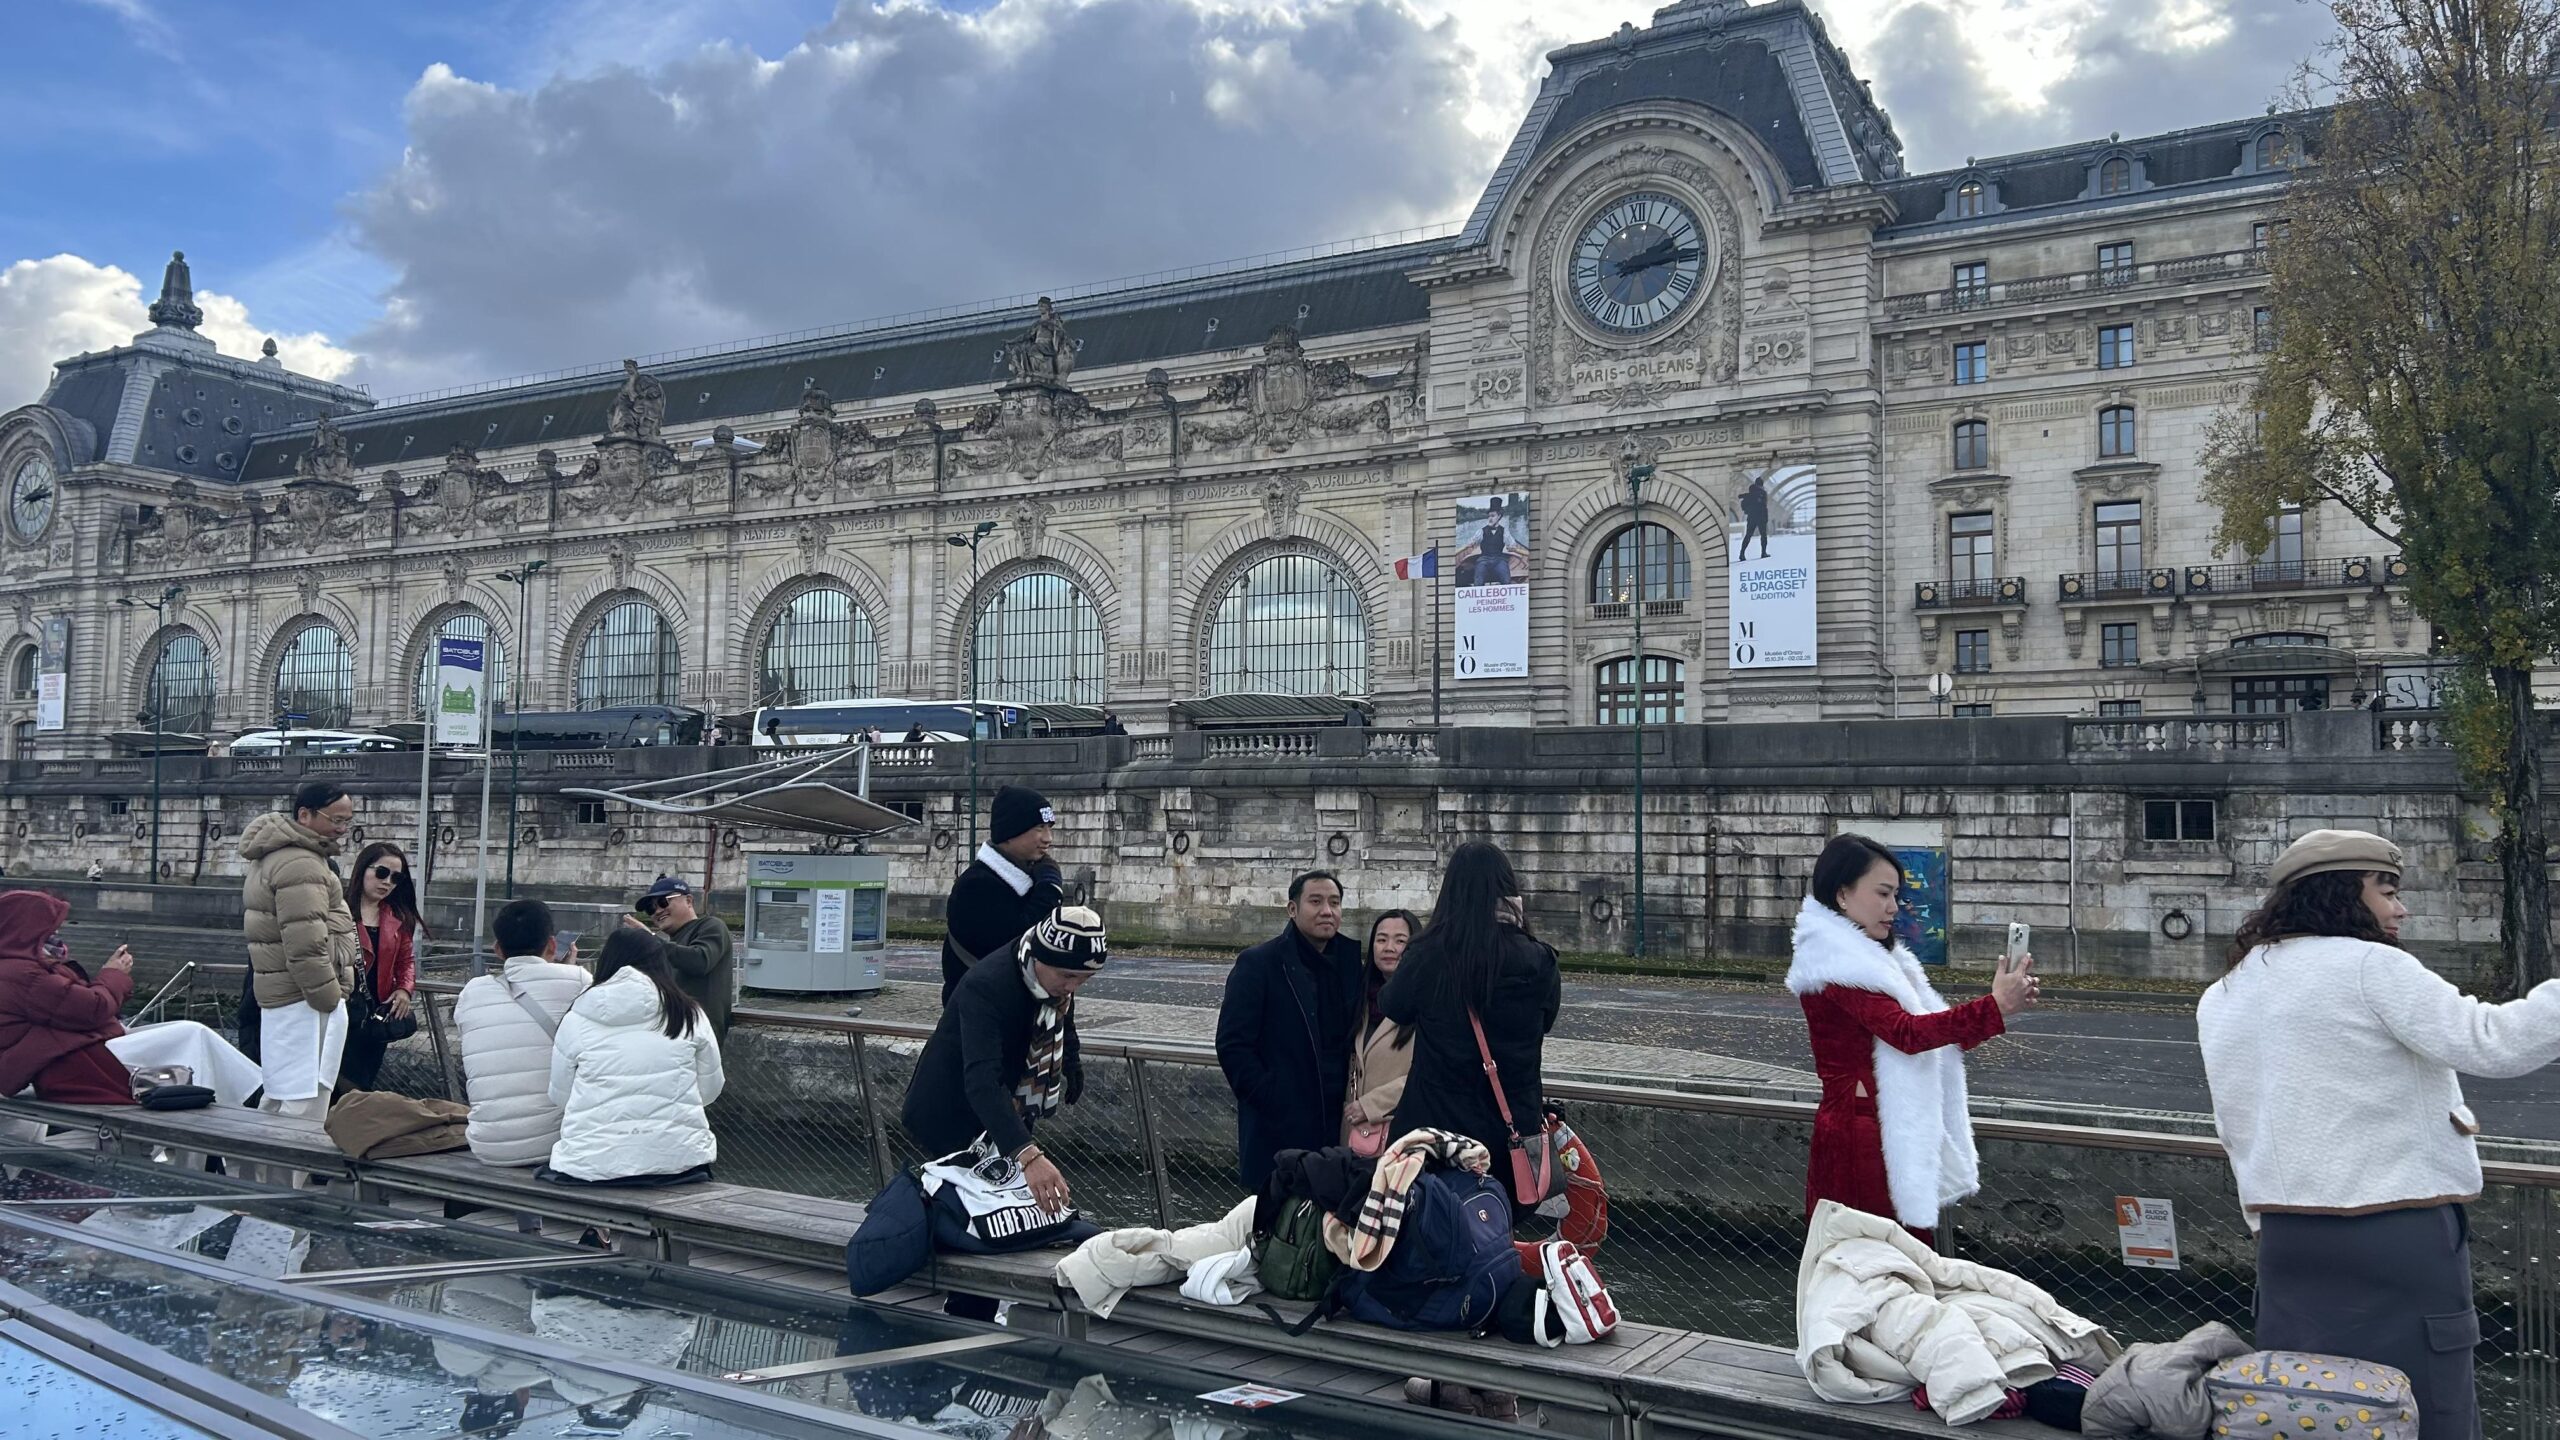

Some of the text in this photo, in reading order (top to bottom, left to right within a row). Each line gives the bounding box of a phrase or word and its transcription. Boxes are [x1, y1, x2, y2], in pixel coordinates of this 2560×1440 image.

[1753, 340, 1793, 364] PO
[1576, 360, 1695, 384] PARIS-ORLEANS
[1478, 376, 1512, 396] PO
[1546, 428, 1728, 461] BLOIS TOURS
[1187, 471, 1381, 500] QUIMPER AURILLAC
[951, 496, 1113, 522] VANNES LORIENT
[744, 519, 885, 541] NANTES ANGERS
[1740, 568, 1807, 582] ELMGREEN
[1458, 586, 1526, 599] CAILLEBOTTE
[1740, 579, 1807, 592] & DRAGSET
[1476, 598, 1507, 606] PEINDRE
[1751, 591, 1795, 601] L'ADDITION
[1483, 604, 1515, 613] HOMMES
[1738, 621, 1753, 639] M
[1463, 635, 1475, 651] M
[986, 1208, 1022, 1238] LIEBE
